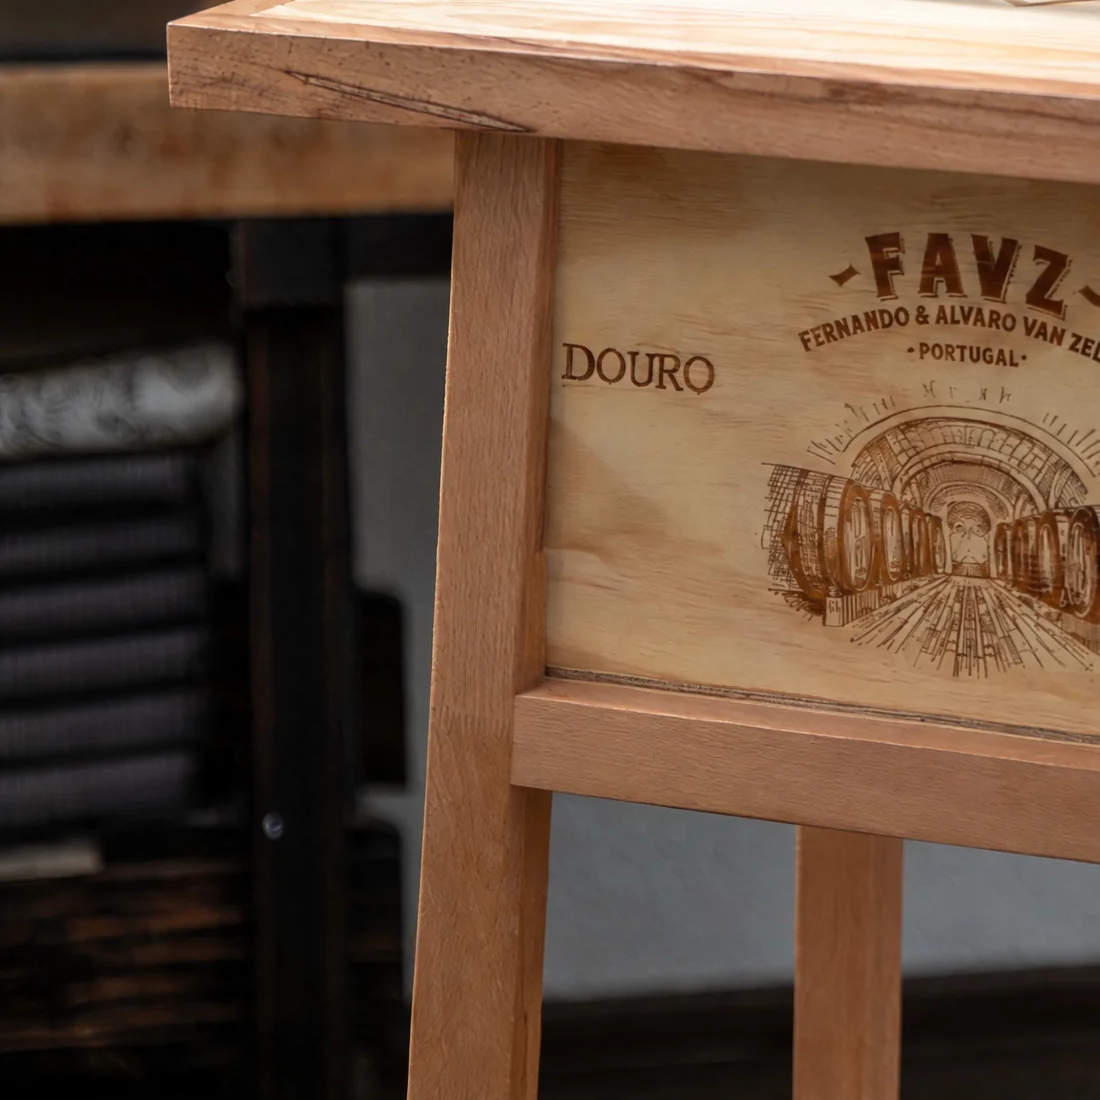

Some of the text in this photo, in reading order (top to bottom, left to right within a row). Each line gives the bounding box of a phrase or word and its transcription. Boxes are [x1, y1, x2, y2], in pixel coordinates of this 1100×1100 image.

[864, 231, 1073, 321] FAVZ
[798, 305, 911, 352] FERNANDO
[914, 304, 930, 325] &
[935, 304, 1018, 333] ALVARO
[1022, 315, 1067, 347] VAN
[561, 342, 715, 395] DOURO
[918, 342, 1020, 368] PORTUGAL
